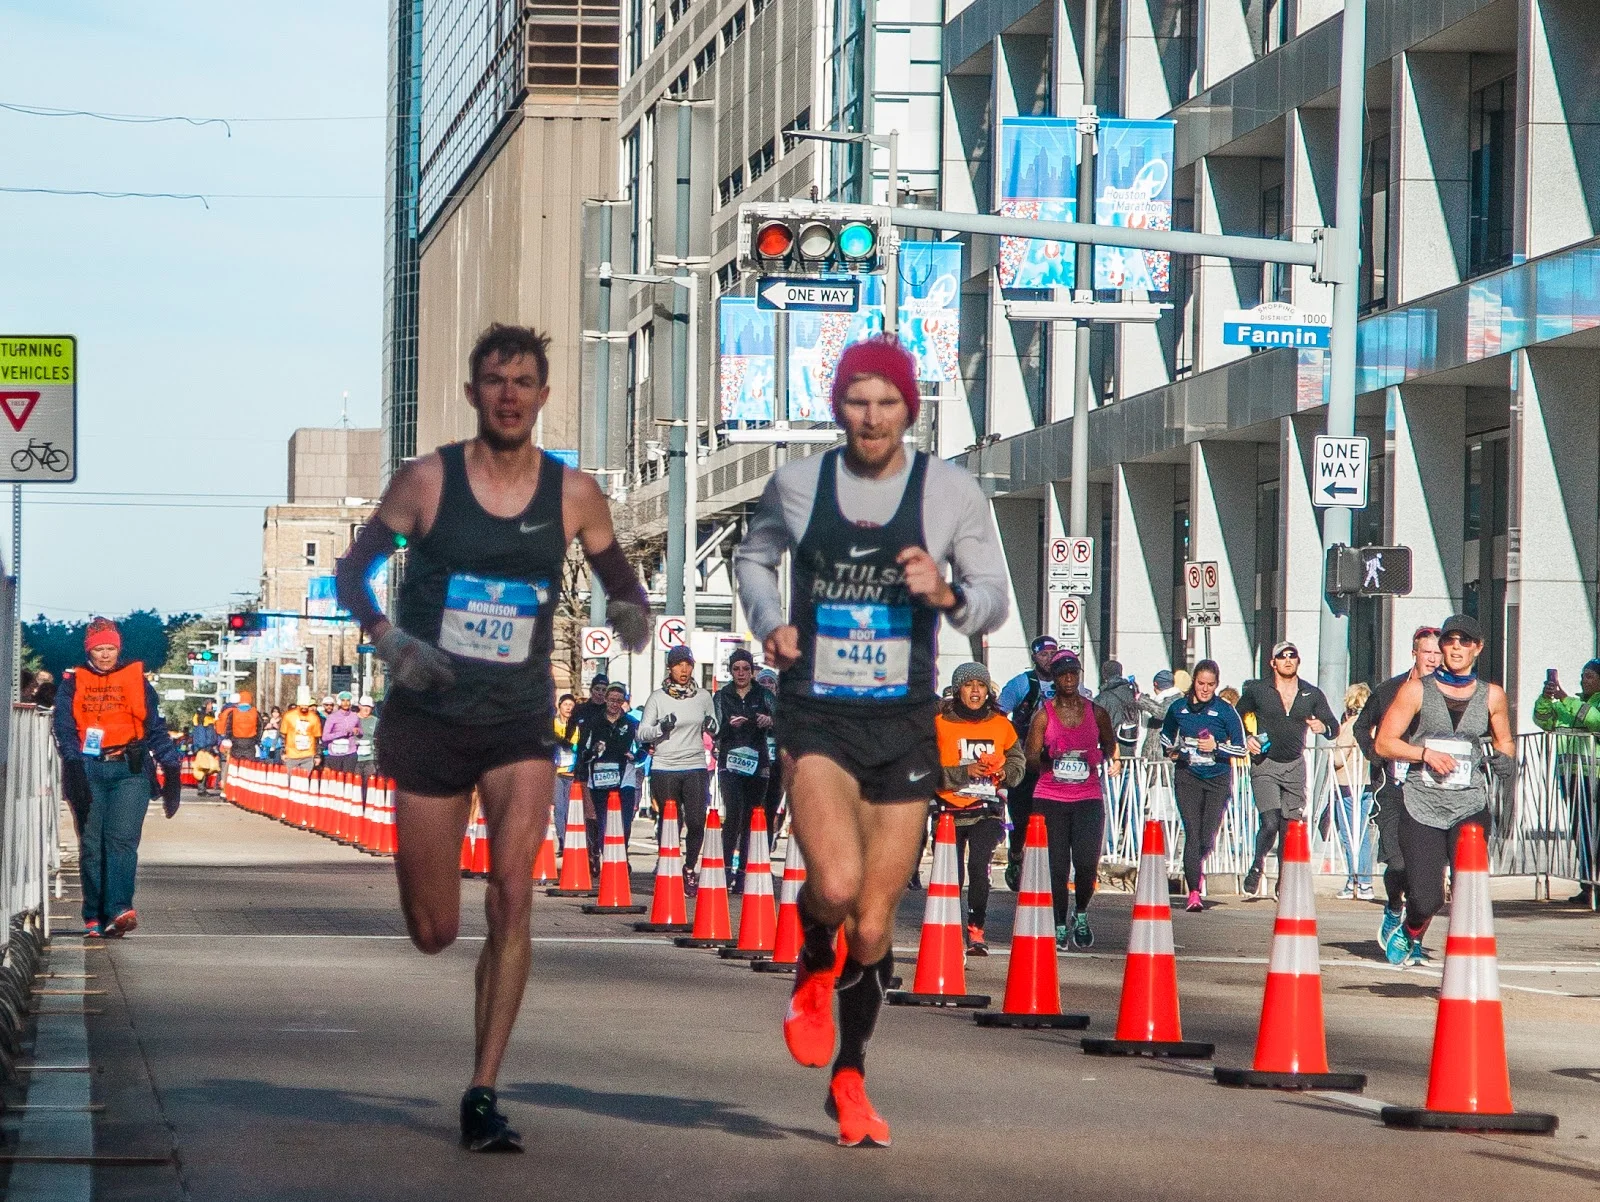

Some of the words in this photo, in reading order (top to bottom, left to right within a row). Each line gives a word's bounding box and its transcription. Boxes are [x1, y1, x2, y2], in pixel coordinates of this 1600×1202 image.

[1107, 190, 1147, 200] Houston
[1116, 201, 1163, 212] Marathon
[787, 288, 816, 302] ONE
[821, 289, 849, 303] WAY
[1258, 303, 1296, 314] SHOPPING
[1303, 314, 1327, 324] 1000
[1238, 326, 1317, 345] Fannin
[1, 343, 62, 357] TURNING
[1, 366, 70, 380] VEHICLES
[1323, 443, 1360, 459] ONE
[1321, 462, 1361, 479] WAY
[467, 600, 518, 617] MORRISON
[849, 628, 877, 640] ROOT
[85, 685, 124, 693] Houston
[728, 755, 756, 769] C32697
